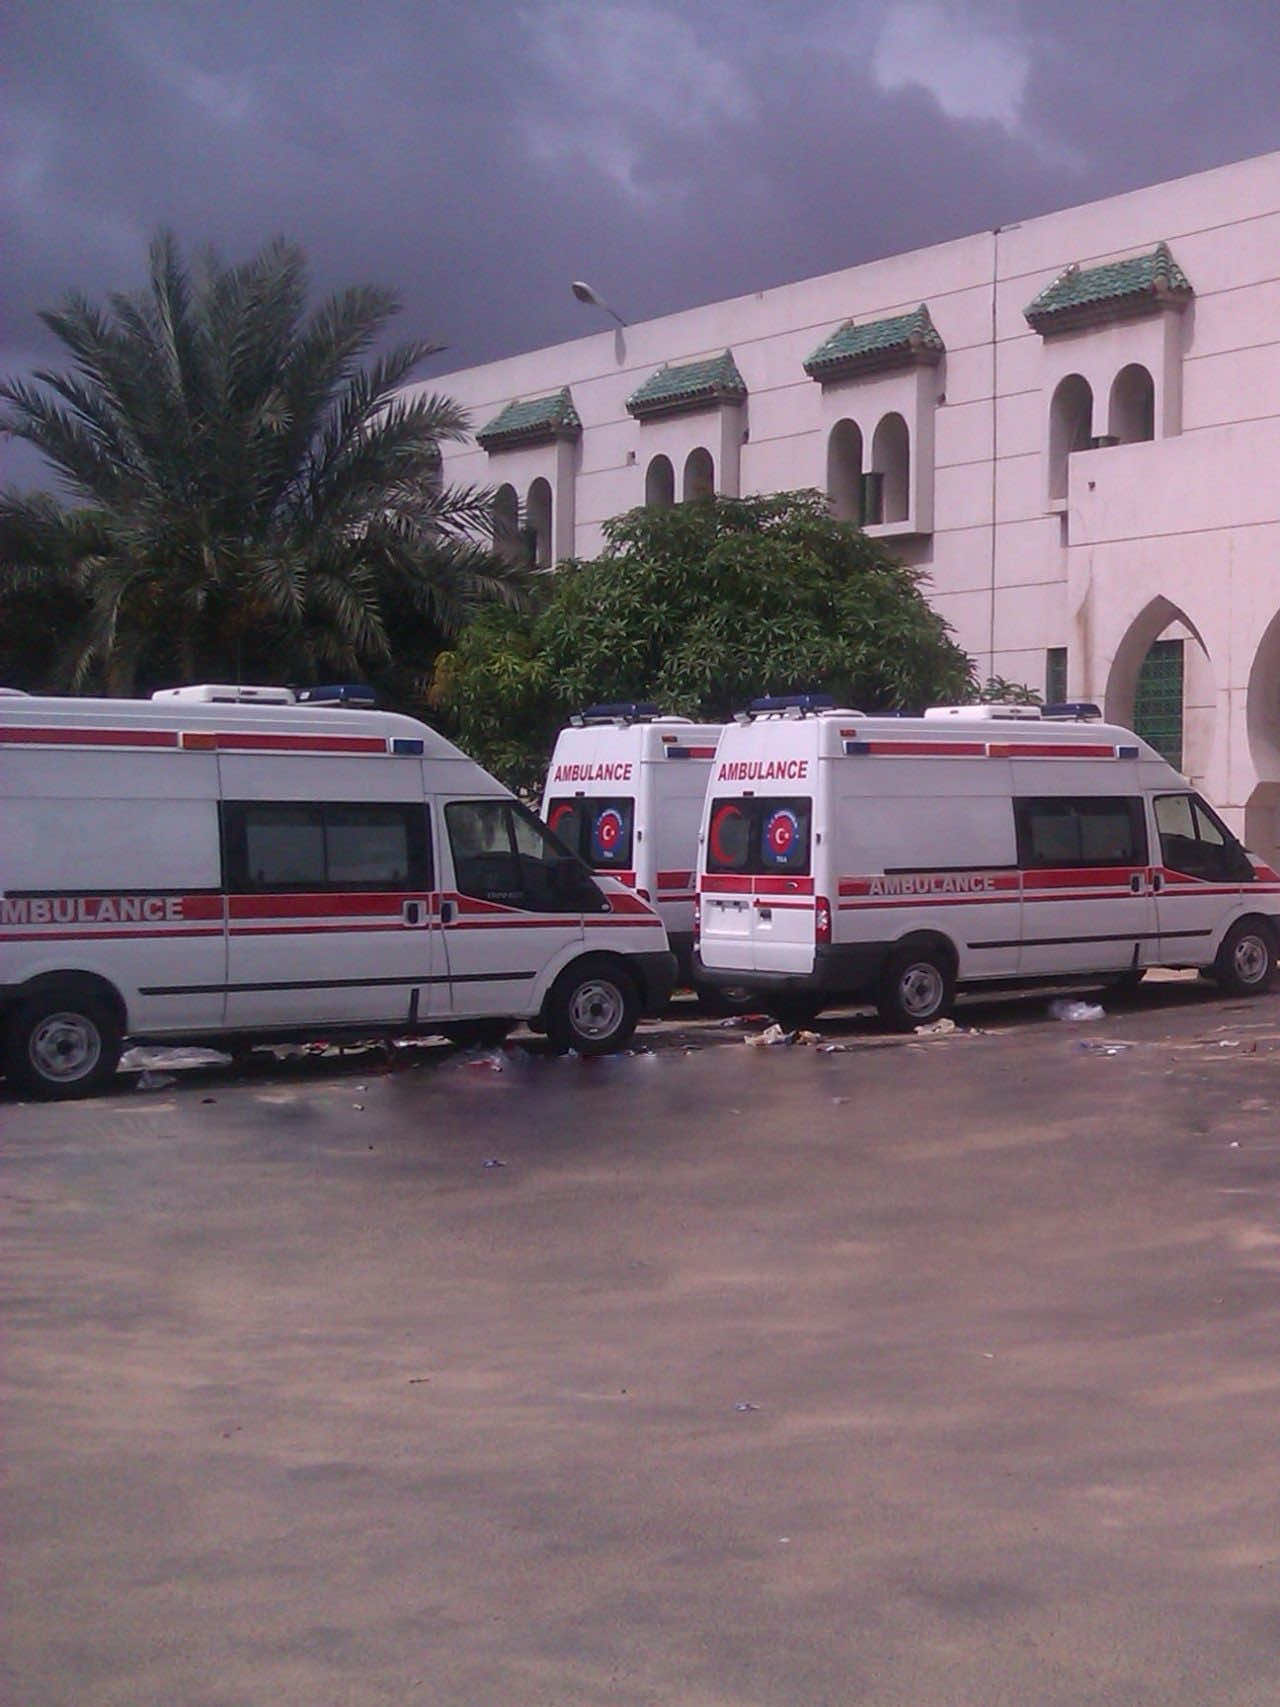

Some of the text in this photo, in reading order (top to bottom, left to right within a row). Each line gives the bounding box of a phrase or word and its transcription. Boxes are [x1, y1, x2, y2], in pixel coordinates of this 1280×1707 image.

[554, 764, 633, 782] AMBULANCE
[718, 760, 808, 781] AMBULANCE
[869, 875, 995, 896] AMBULANCE
[0, 897, 184, 924] MBULANCE
